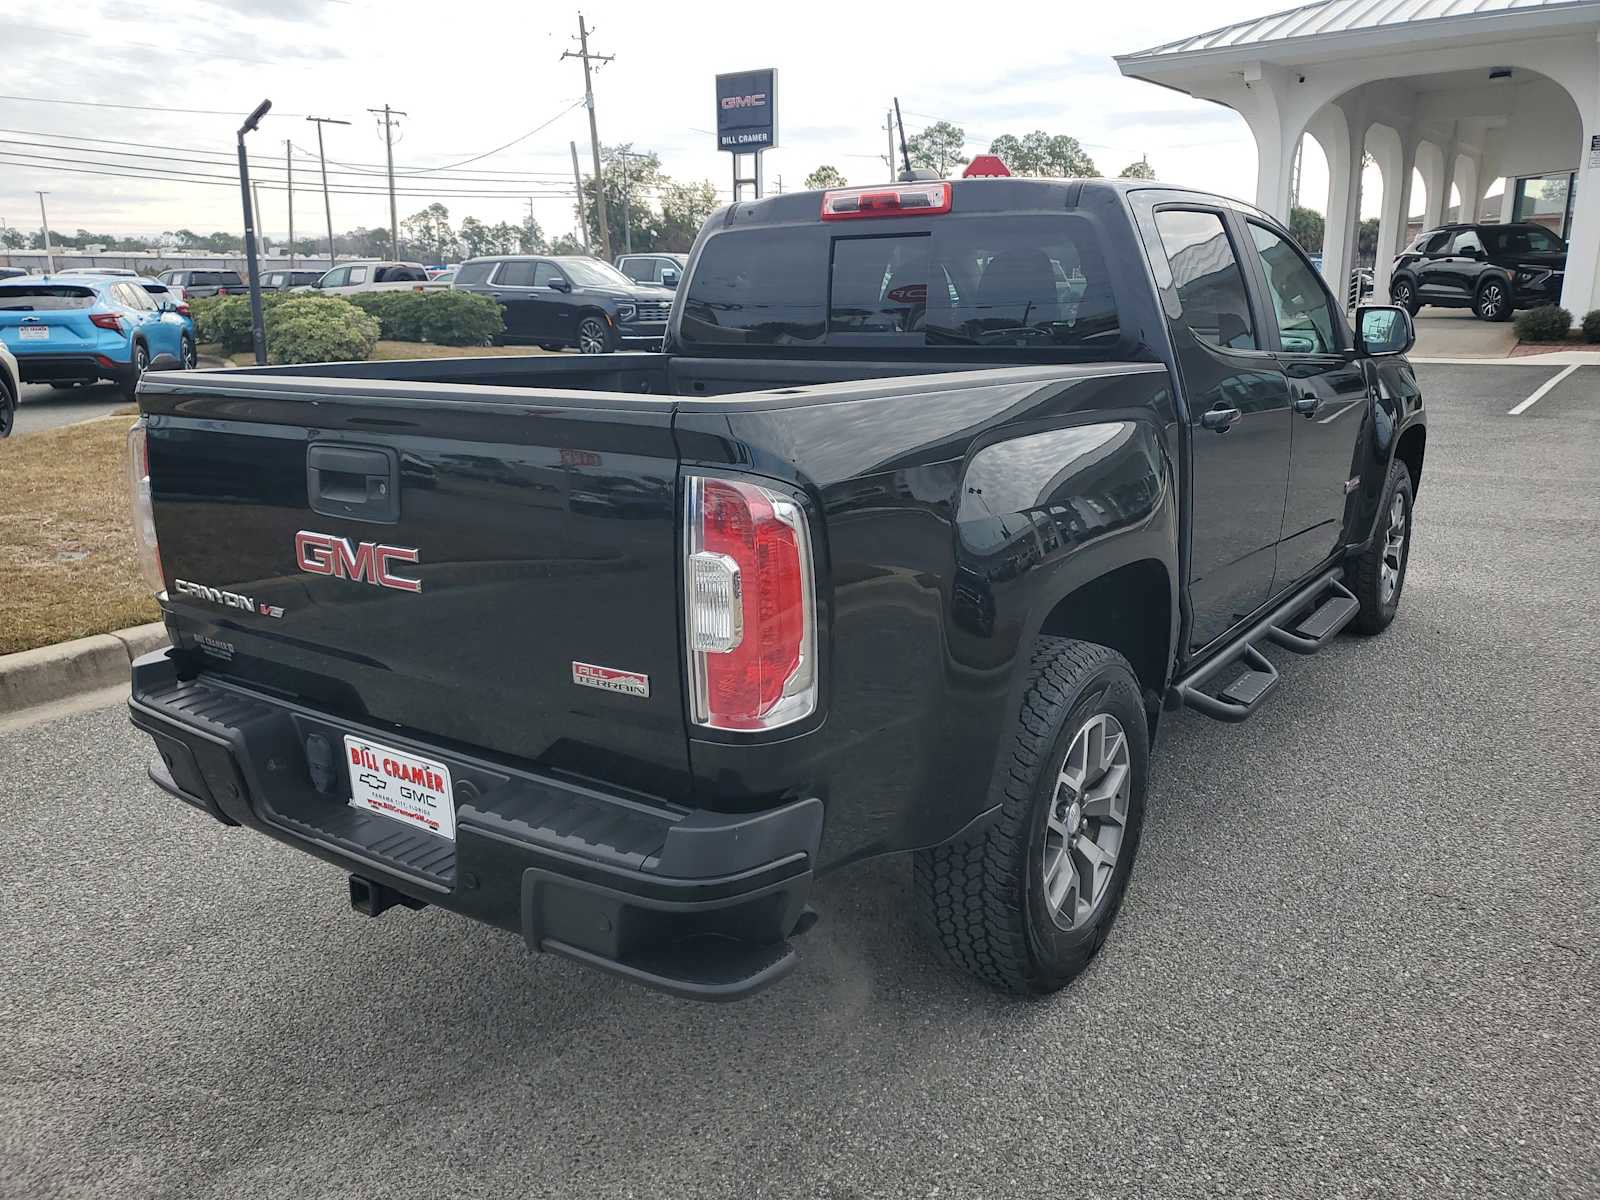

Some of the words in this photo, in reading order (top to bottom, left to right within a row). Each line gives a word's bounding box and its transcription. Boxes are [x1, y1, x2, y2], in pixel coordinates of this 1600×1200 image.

[722, 94, 765, 109] GMC
[722, 136, 736, 144] BILL
[738, 134, 768, 143] CRAMER
[295, 530, 423, 593] GMC
[175, 579, 255, 612] CANYON
[260, 603, 286, 618] V6
[578, 665, 608, 678] ALL
[579, 676, 645, 694] TERRAIN
[351, 747, 379, 772] BILL
[383, 758, 445, 793] CRAMER
[400, 786, 438, 808] GMC
